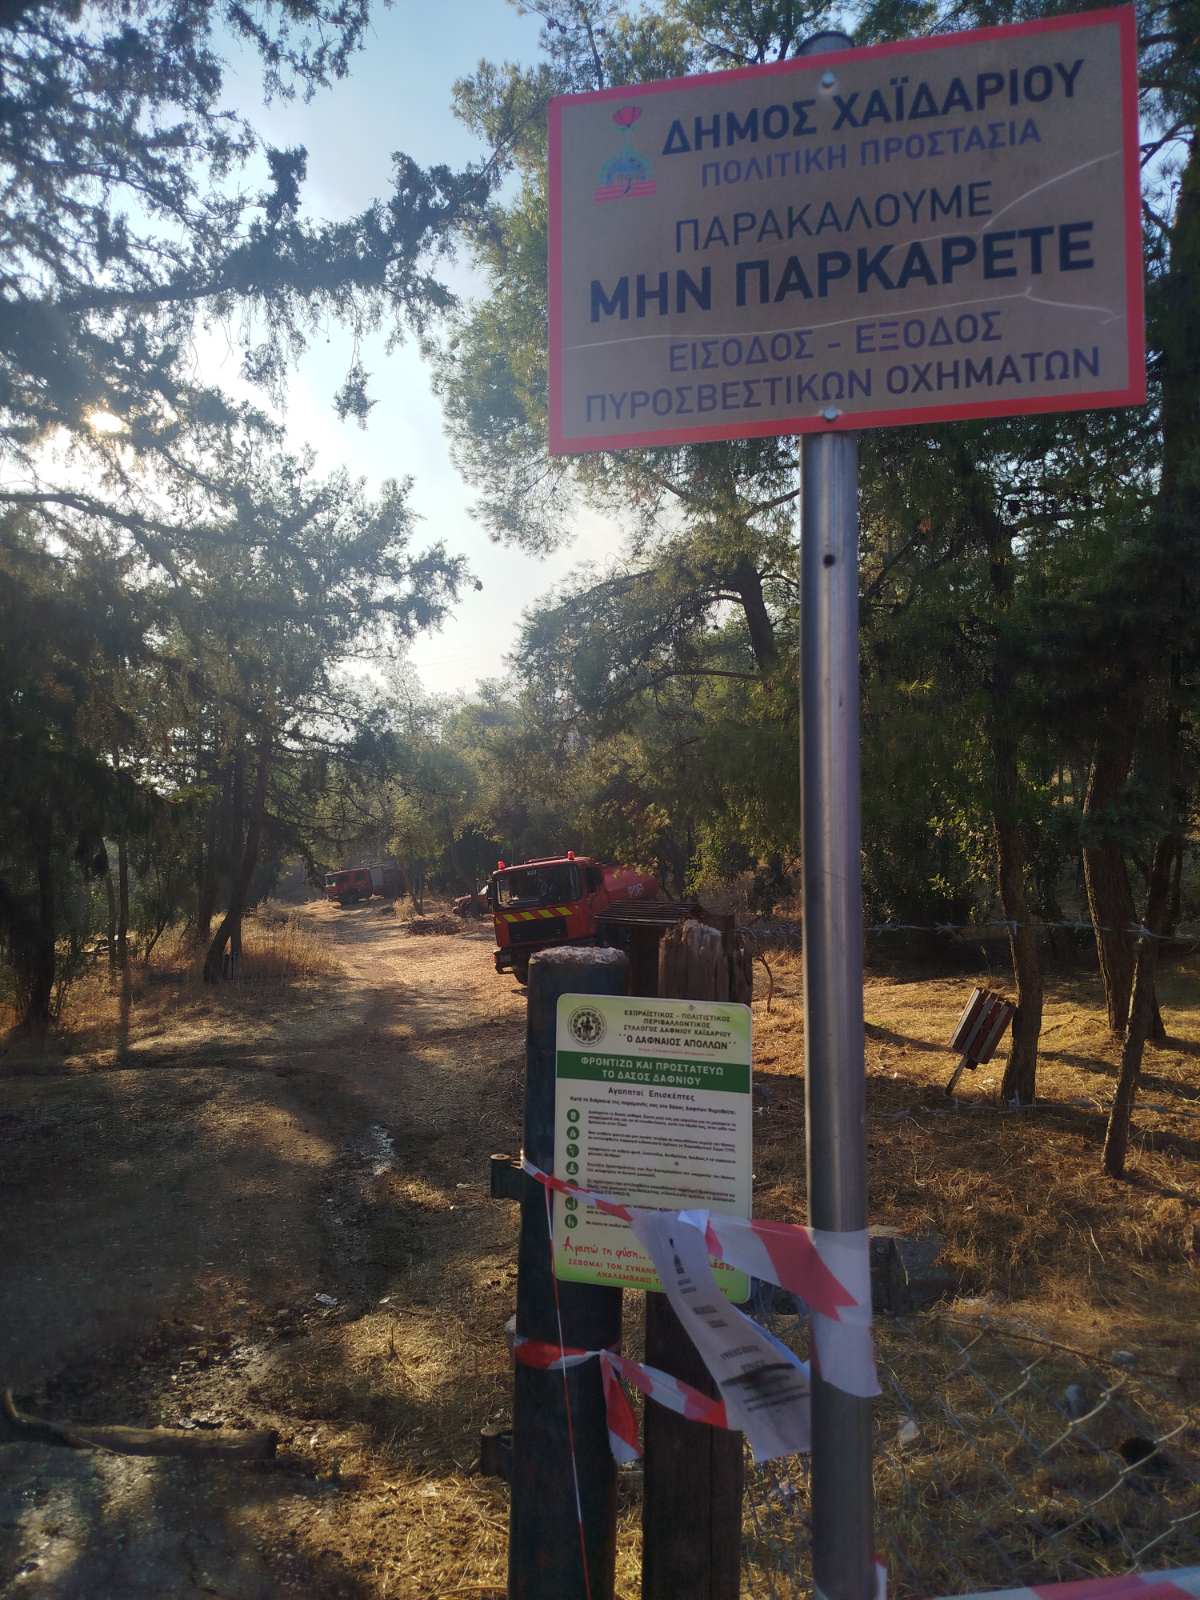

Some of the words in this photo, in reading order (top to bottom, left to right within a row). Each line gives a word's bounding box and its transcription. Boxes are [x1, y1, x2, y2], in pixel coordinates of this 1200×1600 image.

[662, 95, 817, 156] ΔΗΜΟΣ
[831, 59, 1085, 131] ΧΑΪΔΑΡΙΟΥ
[701, 145, 848, 188] ΠΟΛΙΤΙΚΗ
[861, 119, 1041, 165] ΠΡΟΣΤΑΣΙΑ
[675, 180, 994, 254] ΠΑΡΑΚΑΛΟΥΜΕ
[590, 265, 712, 323] ΜΗΝ
[735, 221, 1095, 307] ΠΑΡΚΑΡΕΤΕ
[669, 330, 814, 373] ΕΙΣΟΔΟΣ
[855, 311, 1003, 355] ΕΞΟΔΟΣ
[585, 369, 873, 423] ΠΥΡΟΣΒΕΣΤΙΚΩΝ
[886, 346, 1099, 395] ΟΧΗΜΑΤΩΝ
[581, 1056, 633, 1069] ΦΡΟΝΤΙΖΩ
[636, 1060, 653, 1070] ΚΑΙ
[656, 1061, 724, 1076] ΠΡΟΣΤΑΤΕΥΩ
[635, 1035, 681, 1047] ΔΑΦΝΑΙΟΣ
[602, 1070, 614, 1079] ΤΟ
[617, 1071, 650, 1081] ΔΑΣΟΣ
[653, 1073, 701, 1086] ΔΑΦΝΙΟΥ
